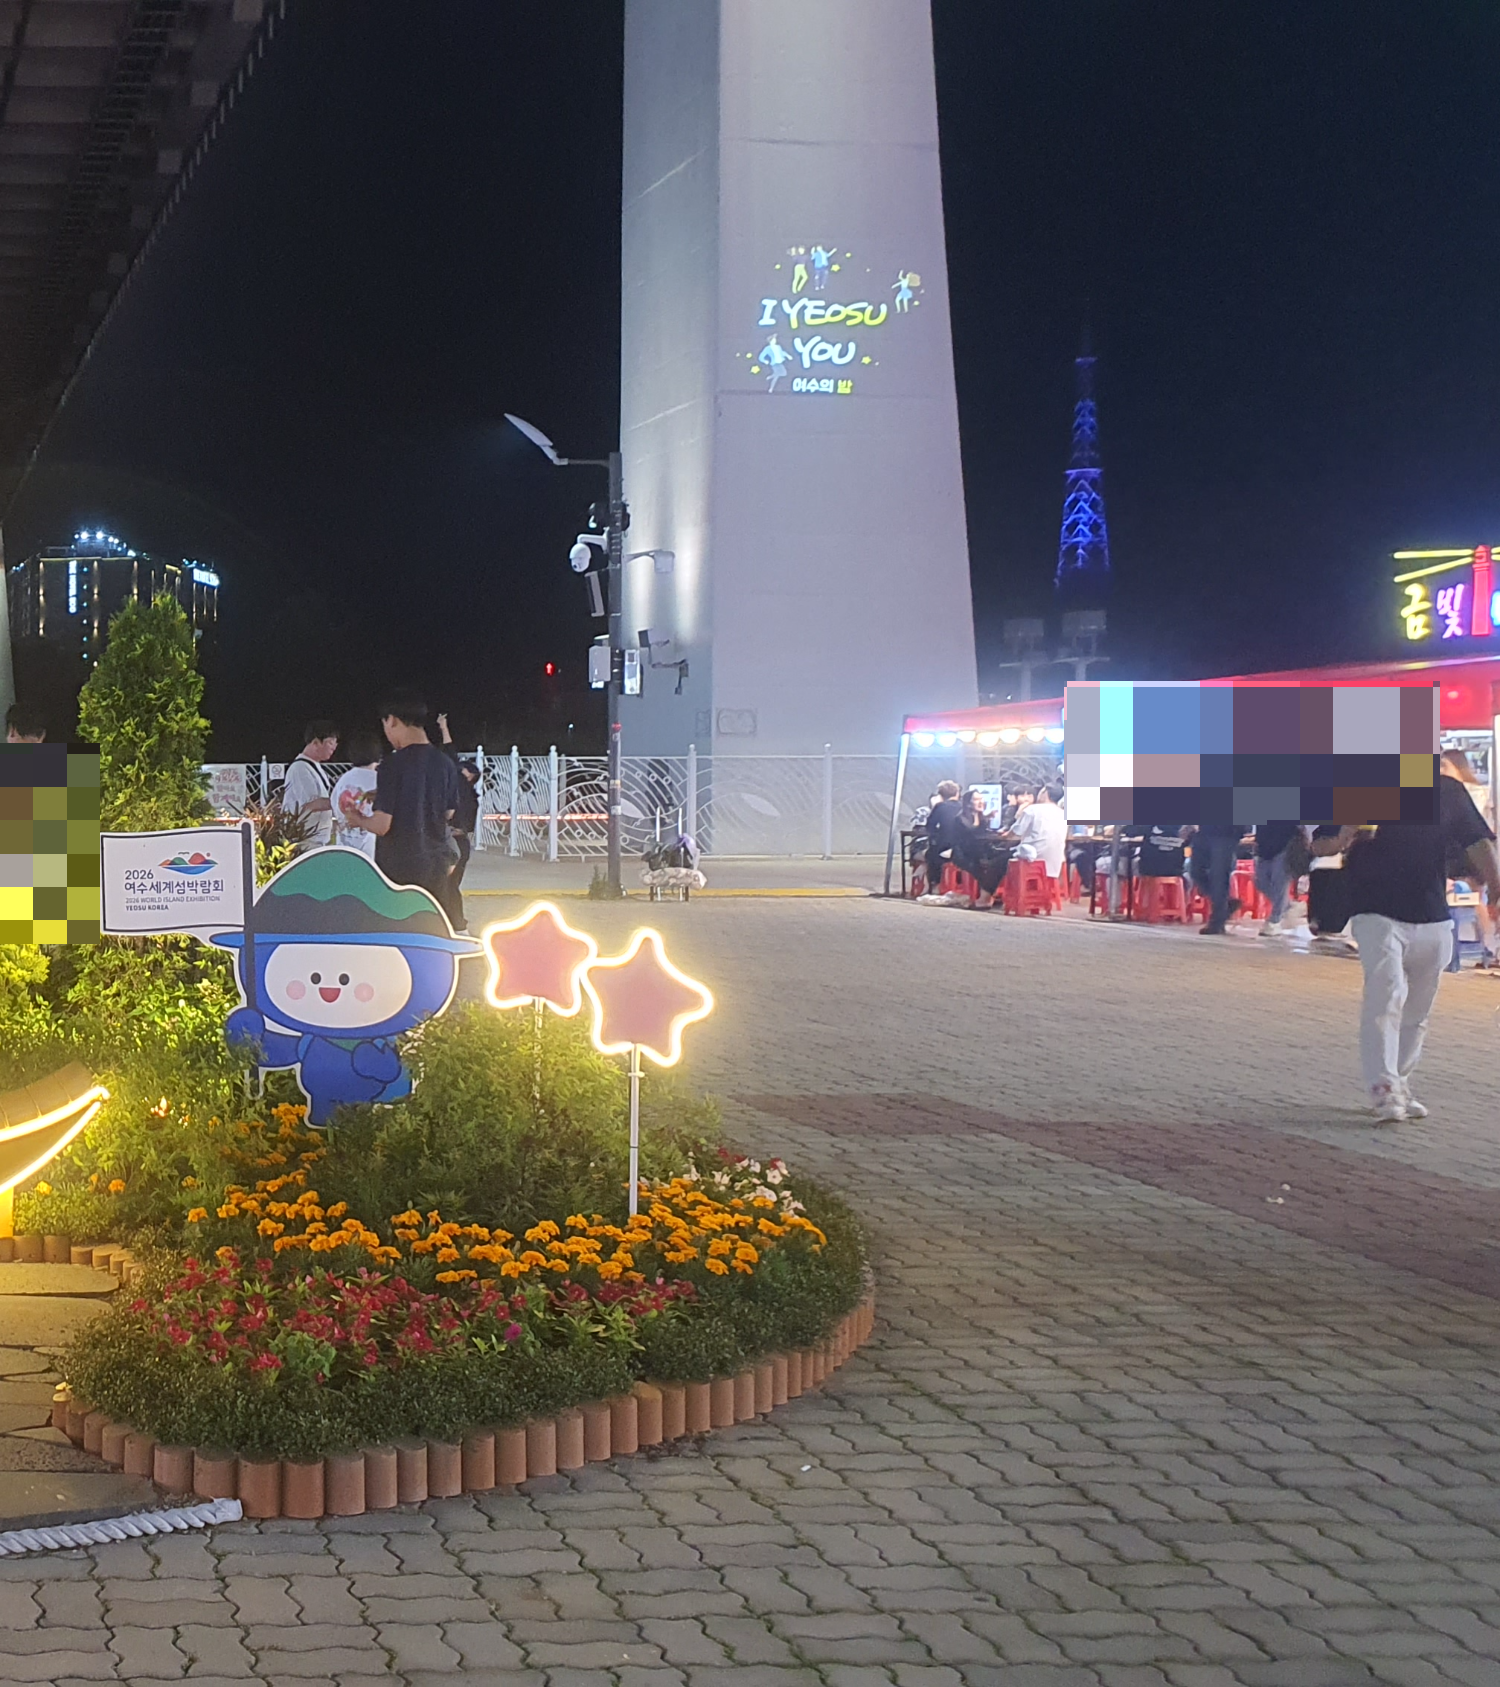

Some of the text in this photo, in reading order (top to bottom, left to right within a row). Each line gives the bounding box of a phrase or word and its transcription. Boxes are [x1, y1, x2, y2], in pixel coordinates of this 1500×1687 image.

[758, 297, 888, 329] I YEOSU
[793, 335, 856, 369] YOU
[792, 377, 853, 394] 여수의 밤
[124, 869, 154, 880] 2026
[124, 880, 224, 894] 여수세계섬박람회
[141, 896, 162, 904] WORLD
[186, 895, 220, 903] EXHIBITION
